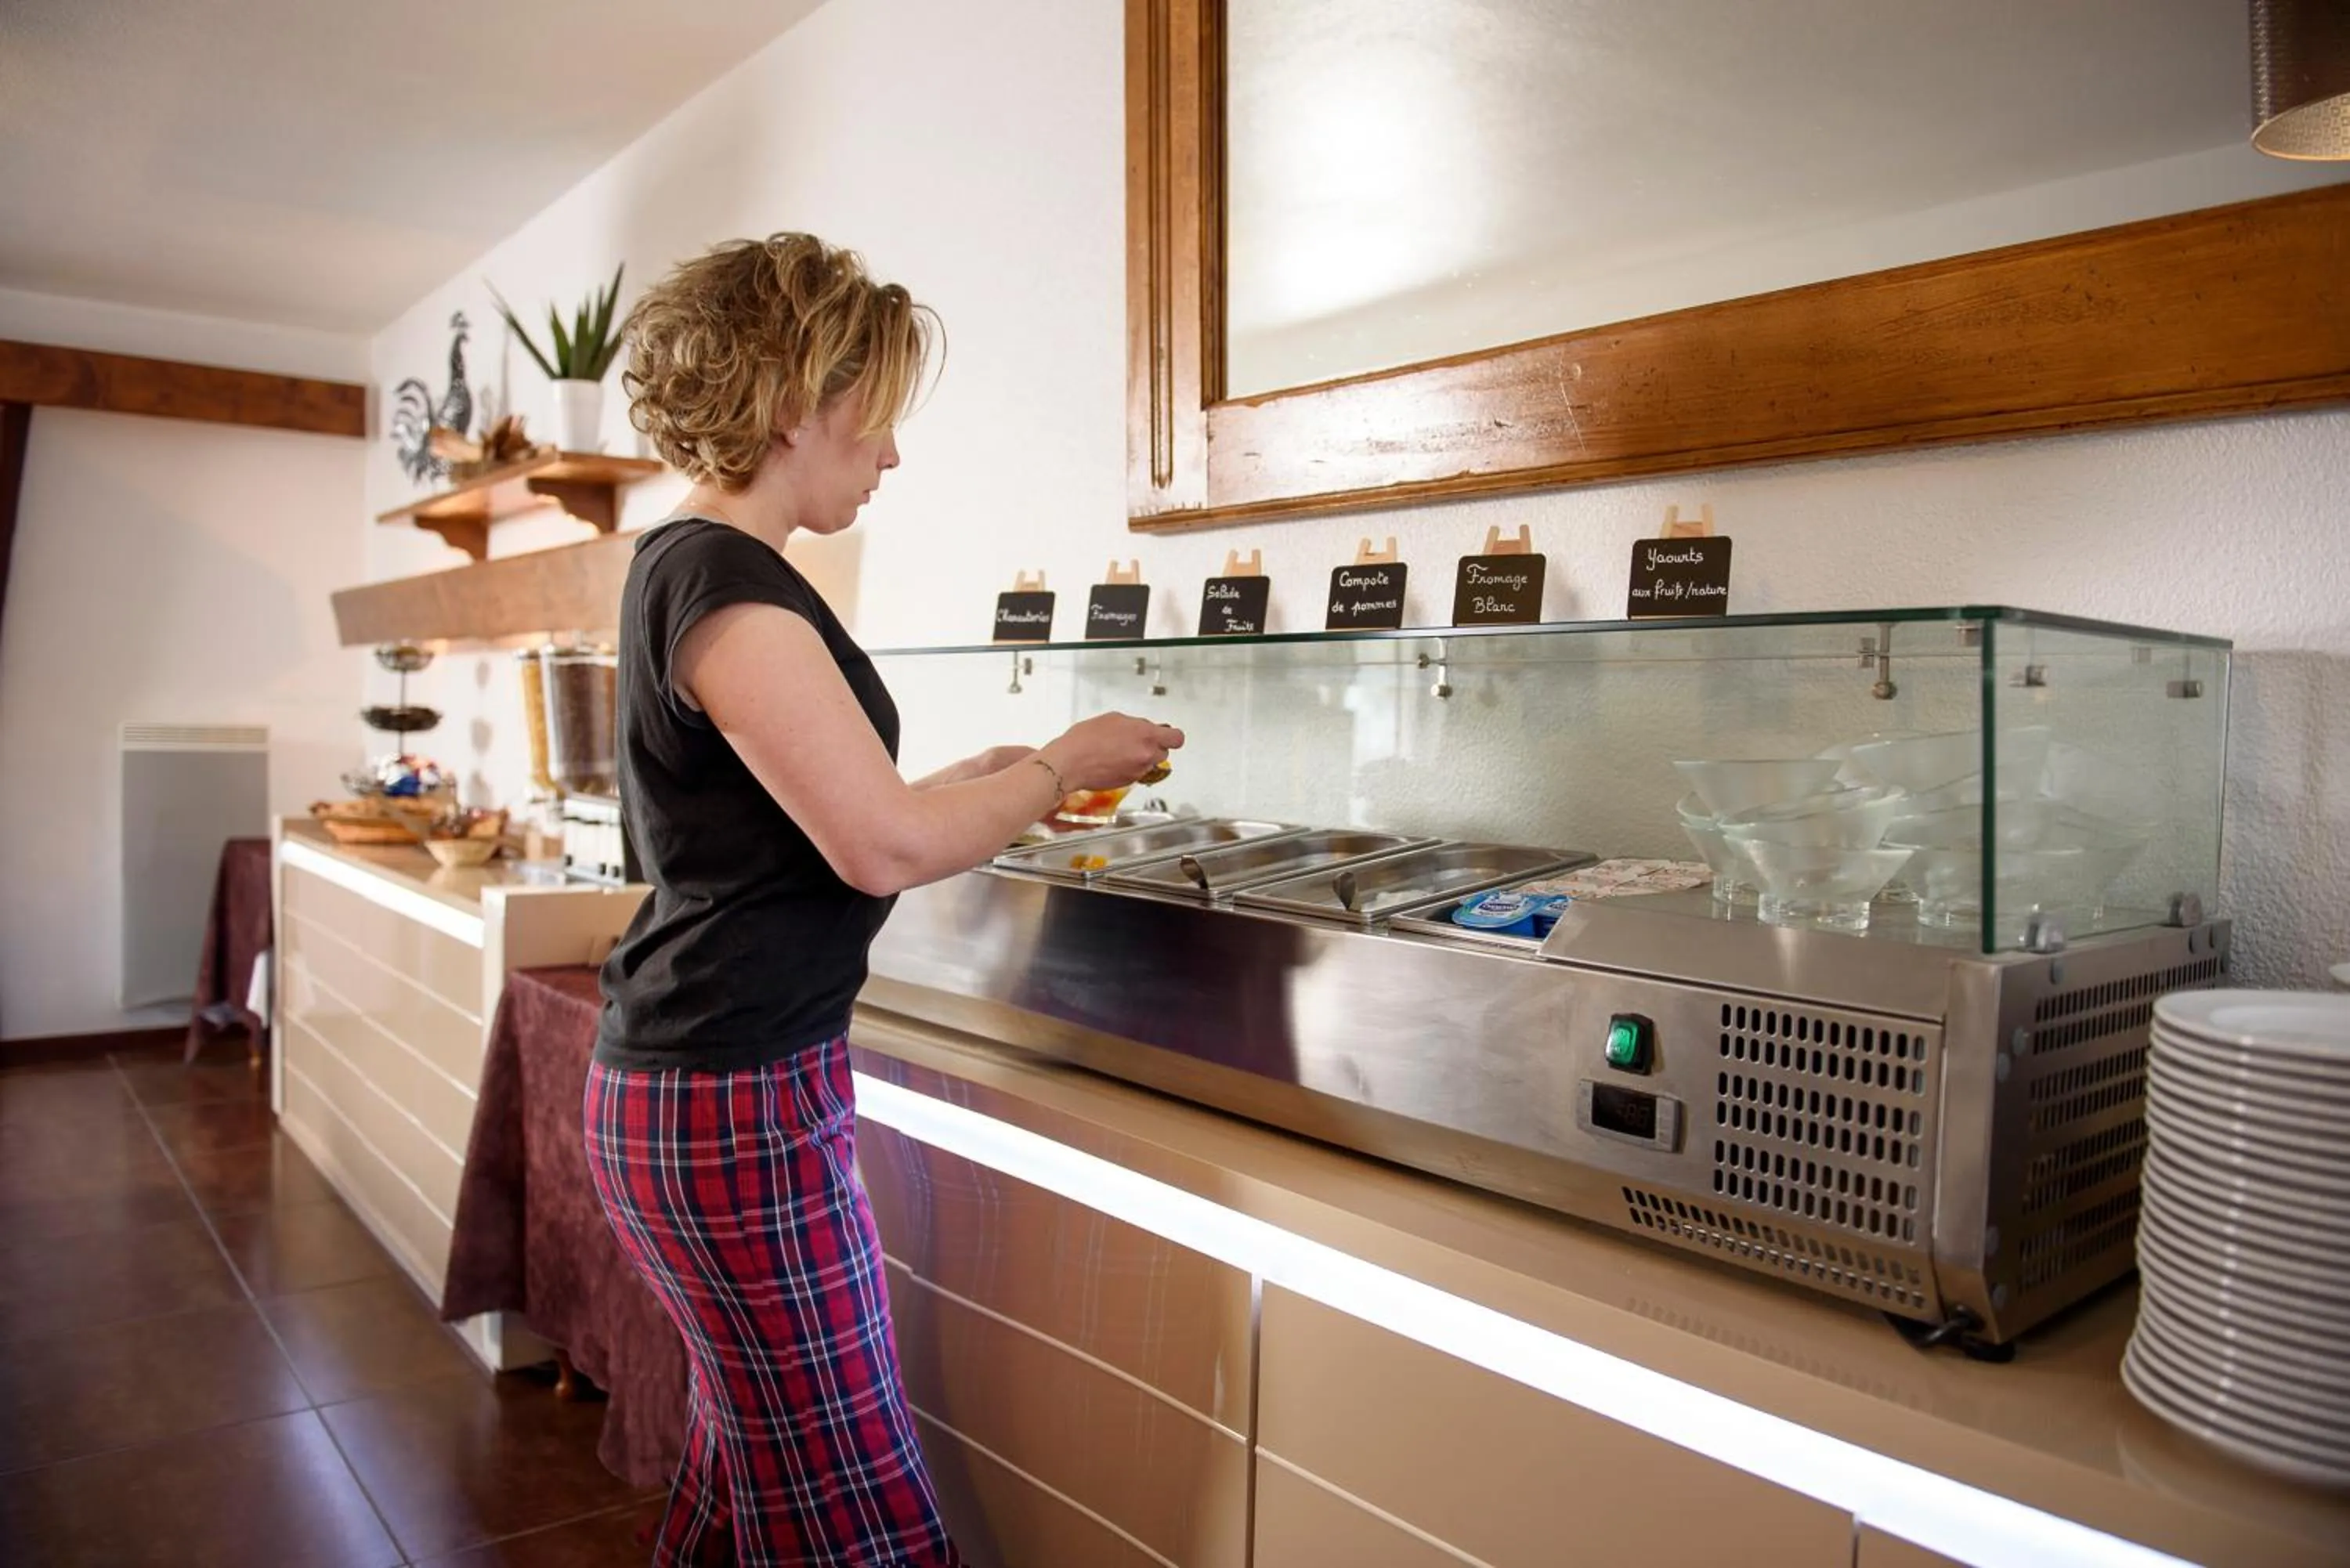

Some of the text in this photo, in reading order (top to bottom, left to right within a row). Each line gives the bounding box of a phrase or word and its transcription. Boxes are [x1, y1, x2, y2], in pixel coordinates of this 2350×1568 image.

[1646, 547, 1704, 571] Yaourts
[1339, 570, 1389, 591] Compote
[1466, 563, 1528, 591] Fromage
[1632, 588, 1651, 597] aux
[1332, 599, 1397, 617] de pommes
[1472, 596, 1516, 613] Blanc
